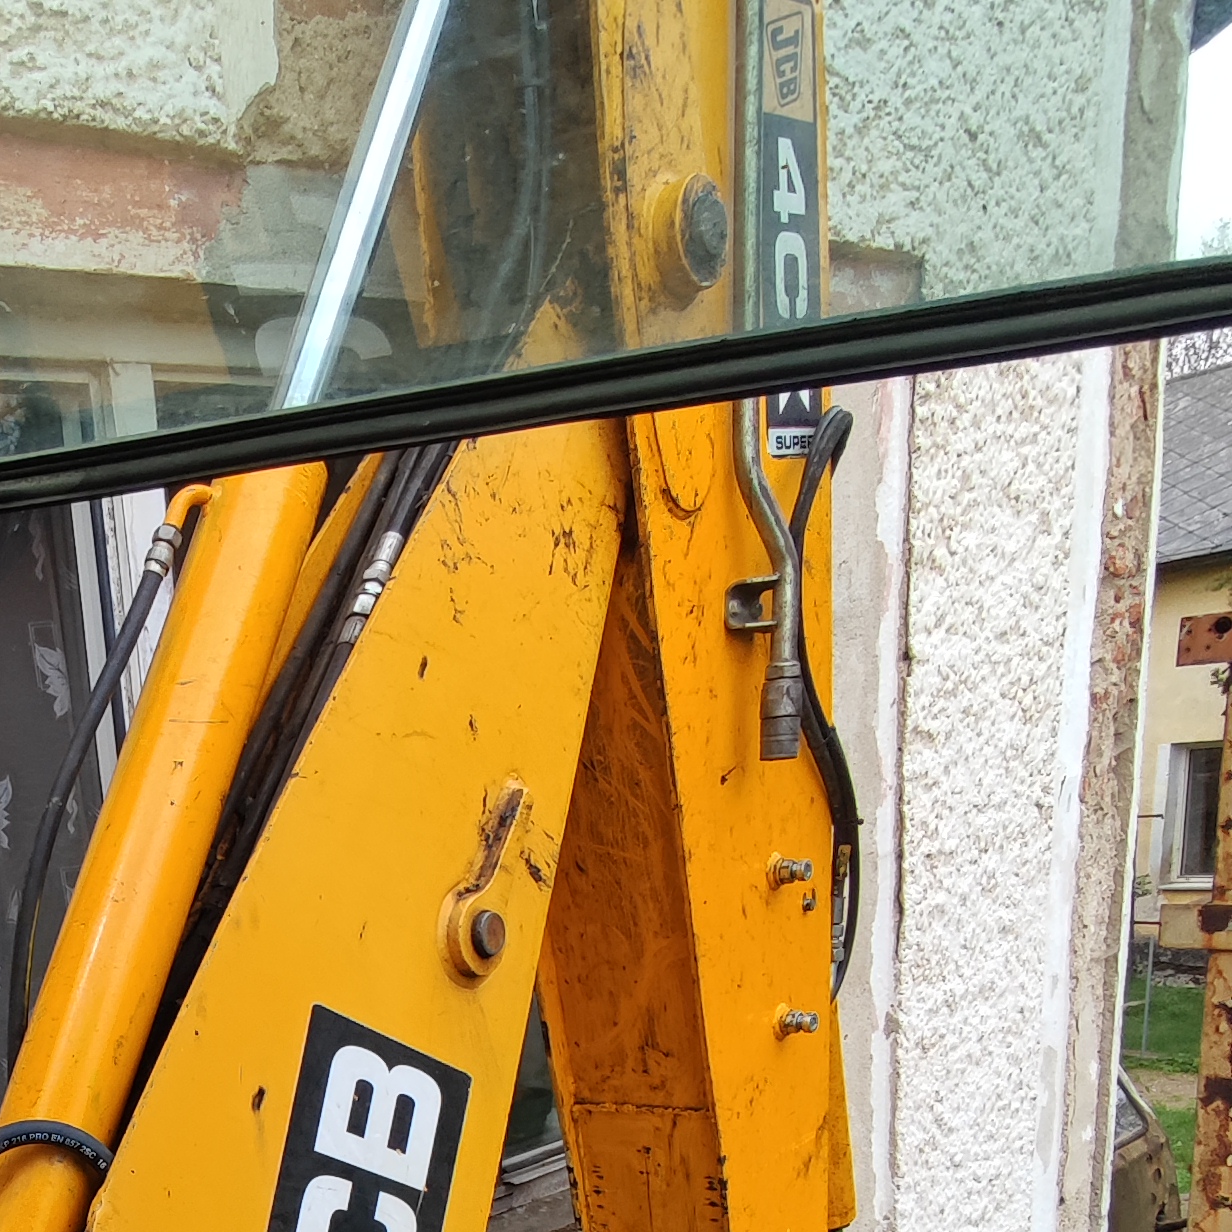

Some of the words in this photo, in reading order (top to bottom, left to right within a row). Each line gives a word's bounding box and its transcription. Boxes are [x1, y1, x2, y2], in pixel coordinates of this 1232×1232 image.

[771, 25, 800, 100] JCB
[29, 1132, 49, 1141] PRO
[51, 1133, 64, 1144] EN
[64, 1137, 81, 1149] 857
[79, 1145, 97, 1160] 2SC
